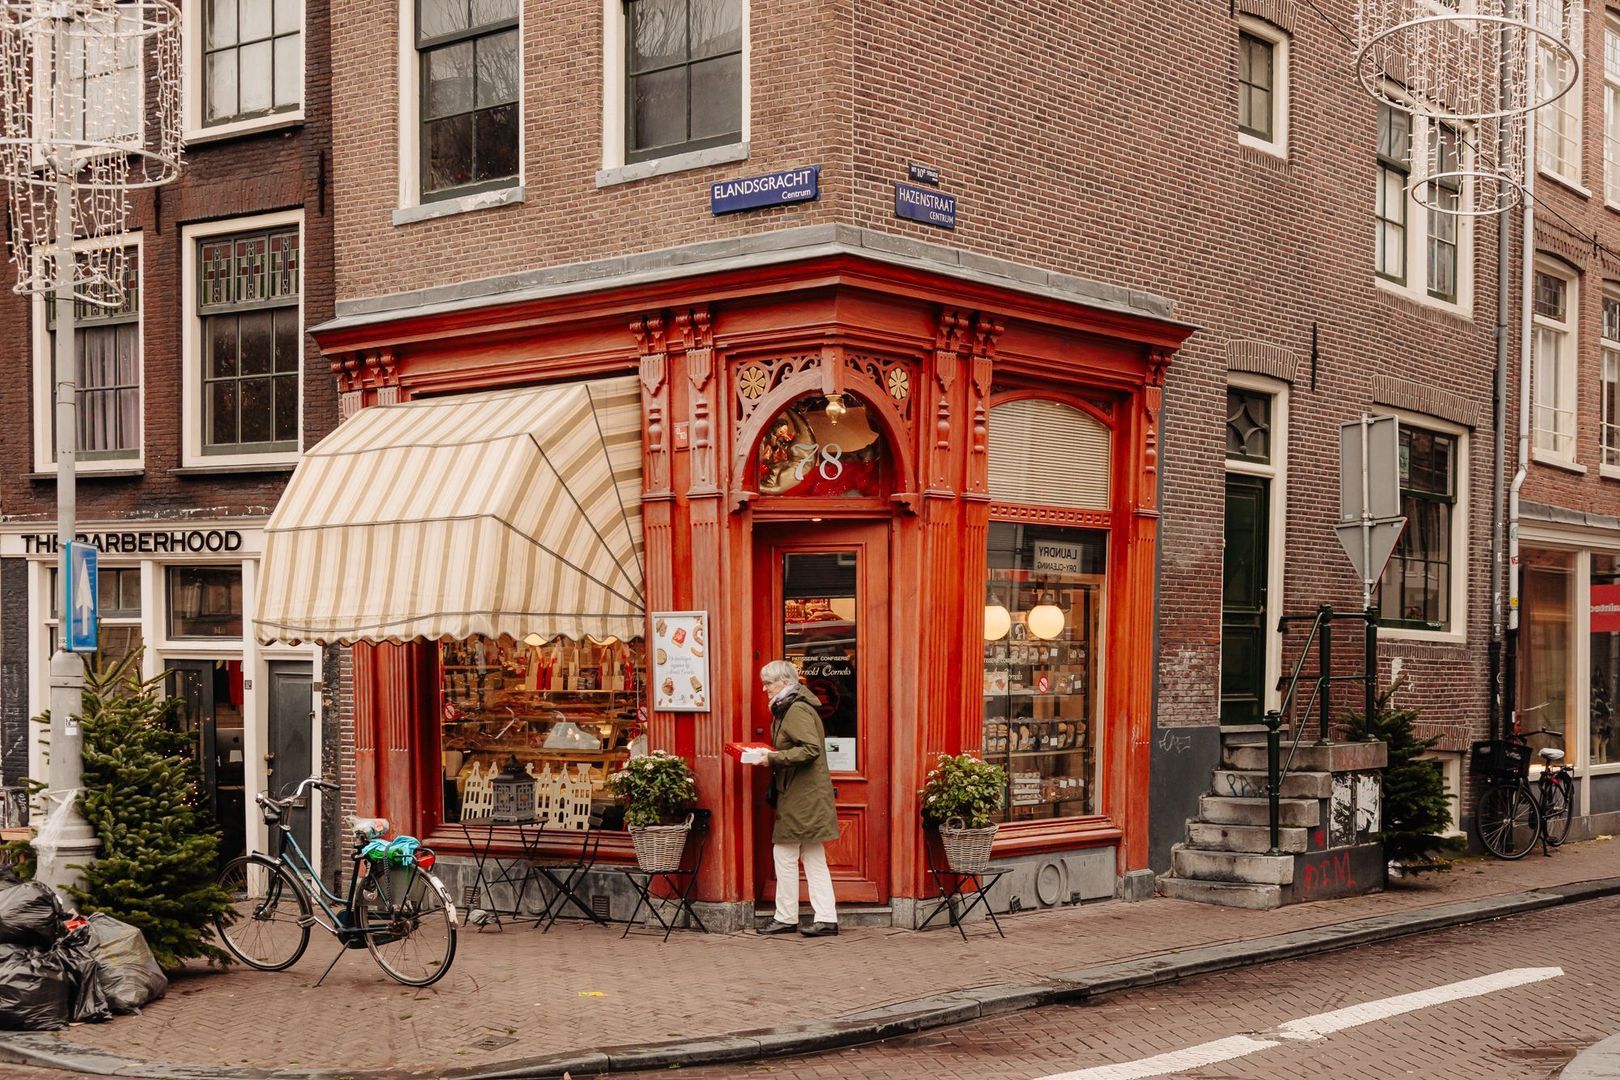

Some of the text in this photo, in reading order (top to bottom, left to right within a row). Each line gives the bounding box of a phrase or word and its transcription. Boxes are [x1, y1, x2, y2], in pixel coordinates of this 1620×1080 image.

[714, 170, 810, 199] ELANDSGRACHT
[782, 189, 811, 200] Centrum
[899, 187, 954, 213] HAZENSTRAAT
[930, 211, 954, 224] CENTRUM
[791, 443, 843, 481] 78
